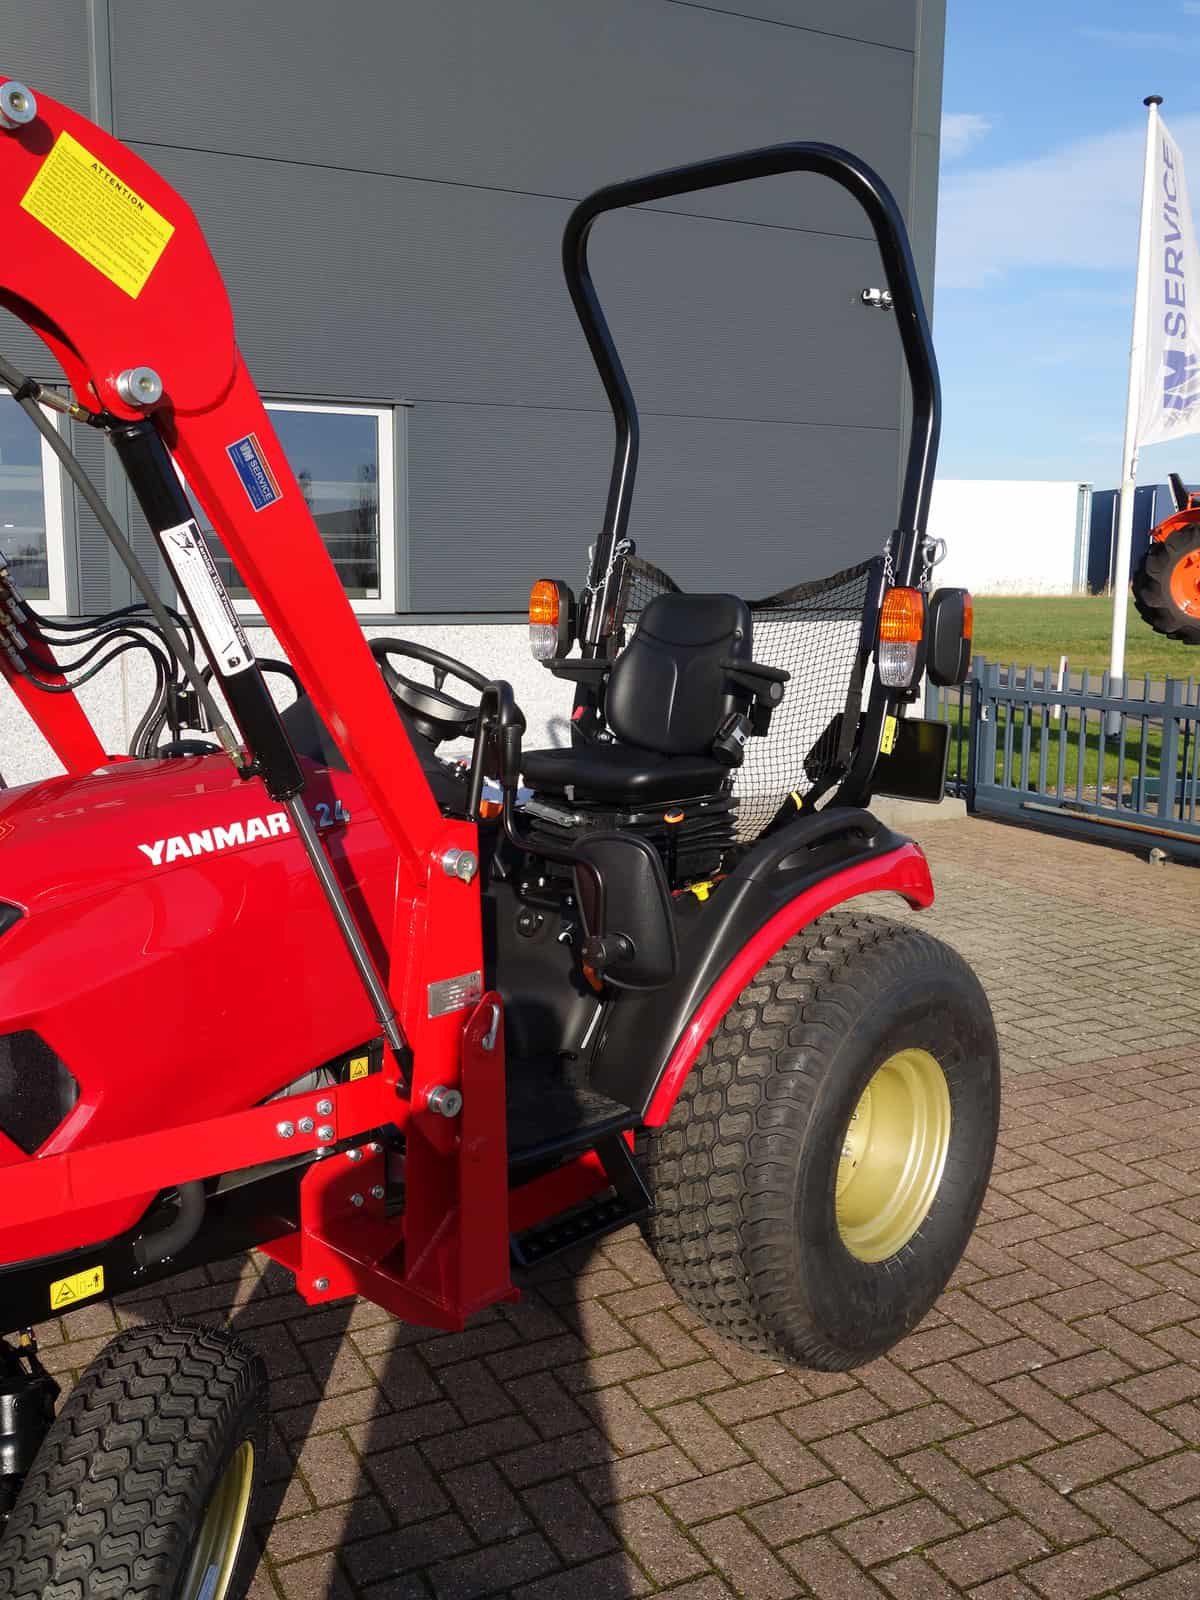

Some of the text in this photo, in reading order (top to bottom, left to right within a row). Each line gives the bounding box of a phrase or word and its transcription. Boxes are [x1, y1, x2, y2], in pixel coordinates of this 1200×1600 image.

[91, 163, 144, 210] ATTENTION
[1163, 136, 1187, 339] SERVICE
[250, 459, 273, 500] SERVICE
[315, 799, 350, 827] 24
[137, 812, 291, 866] YANMAR
